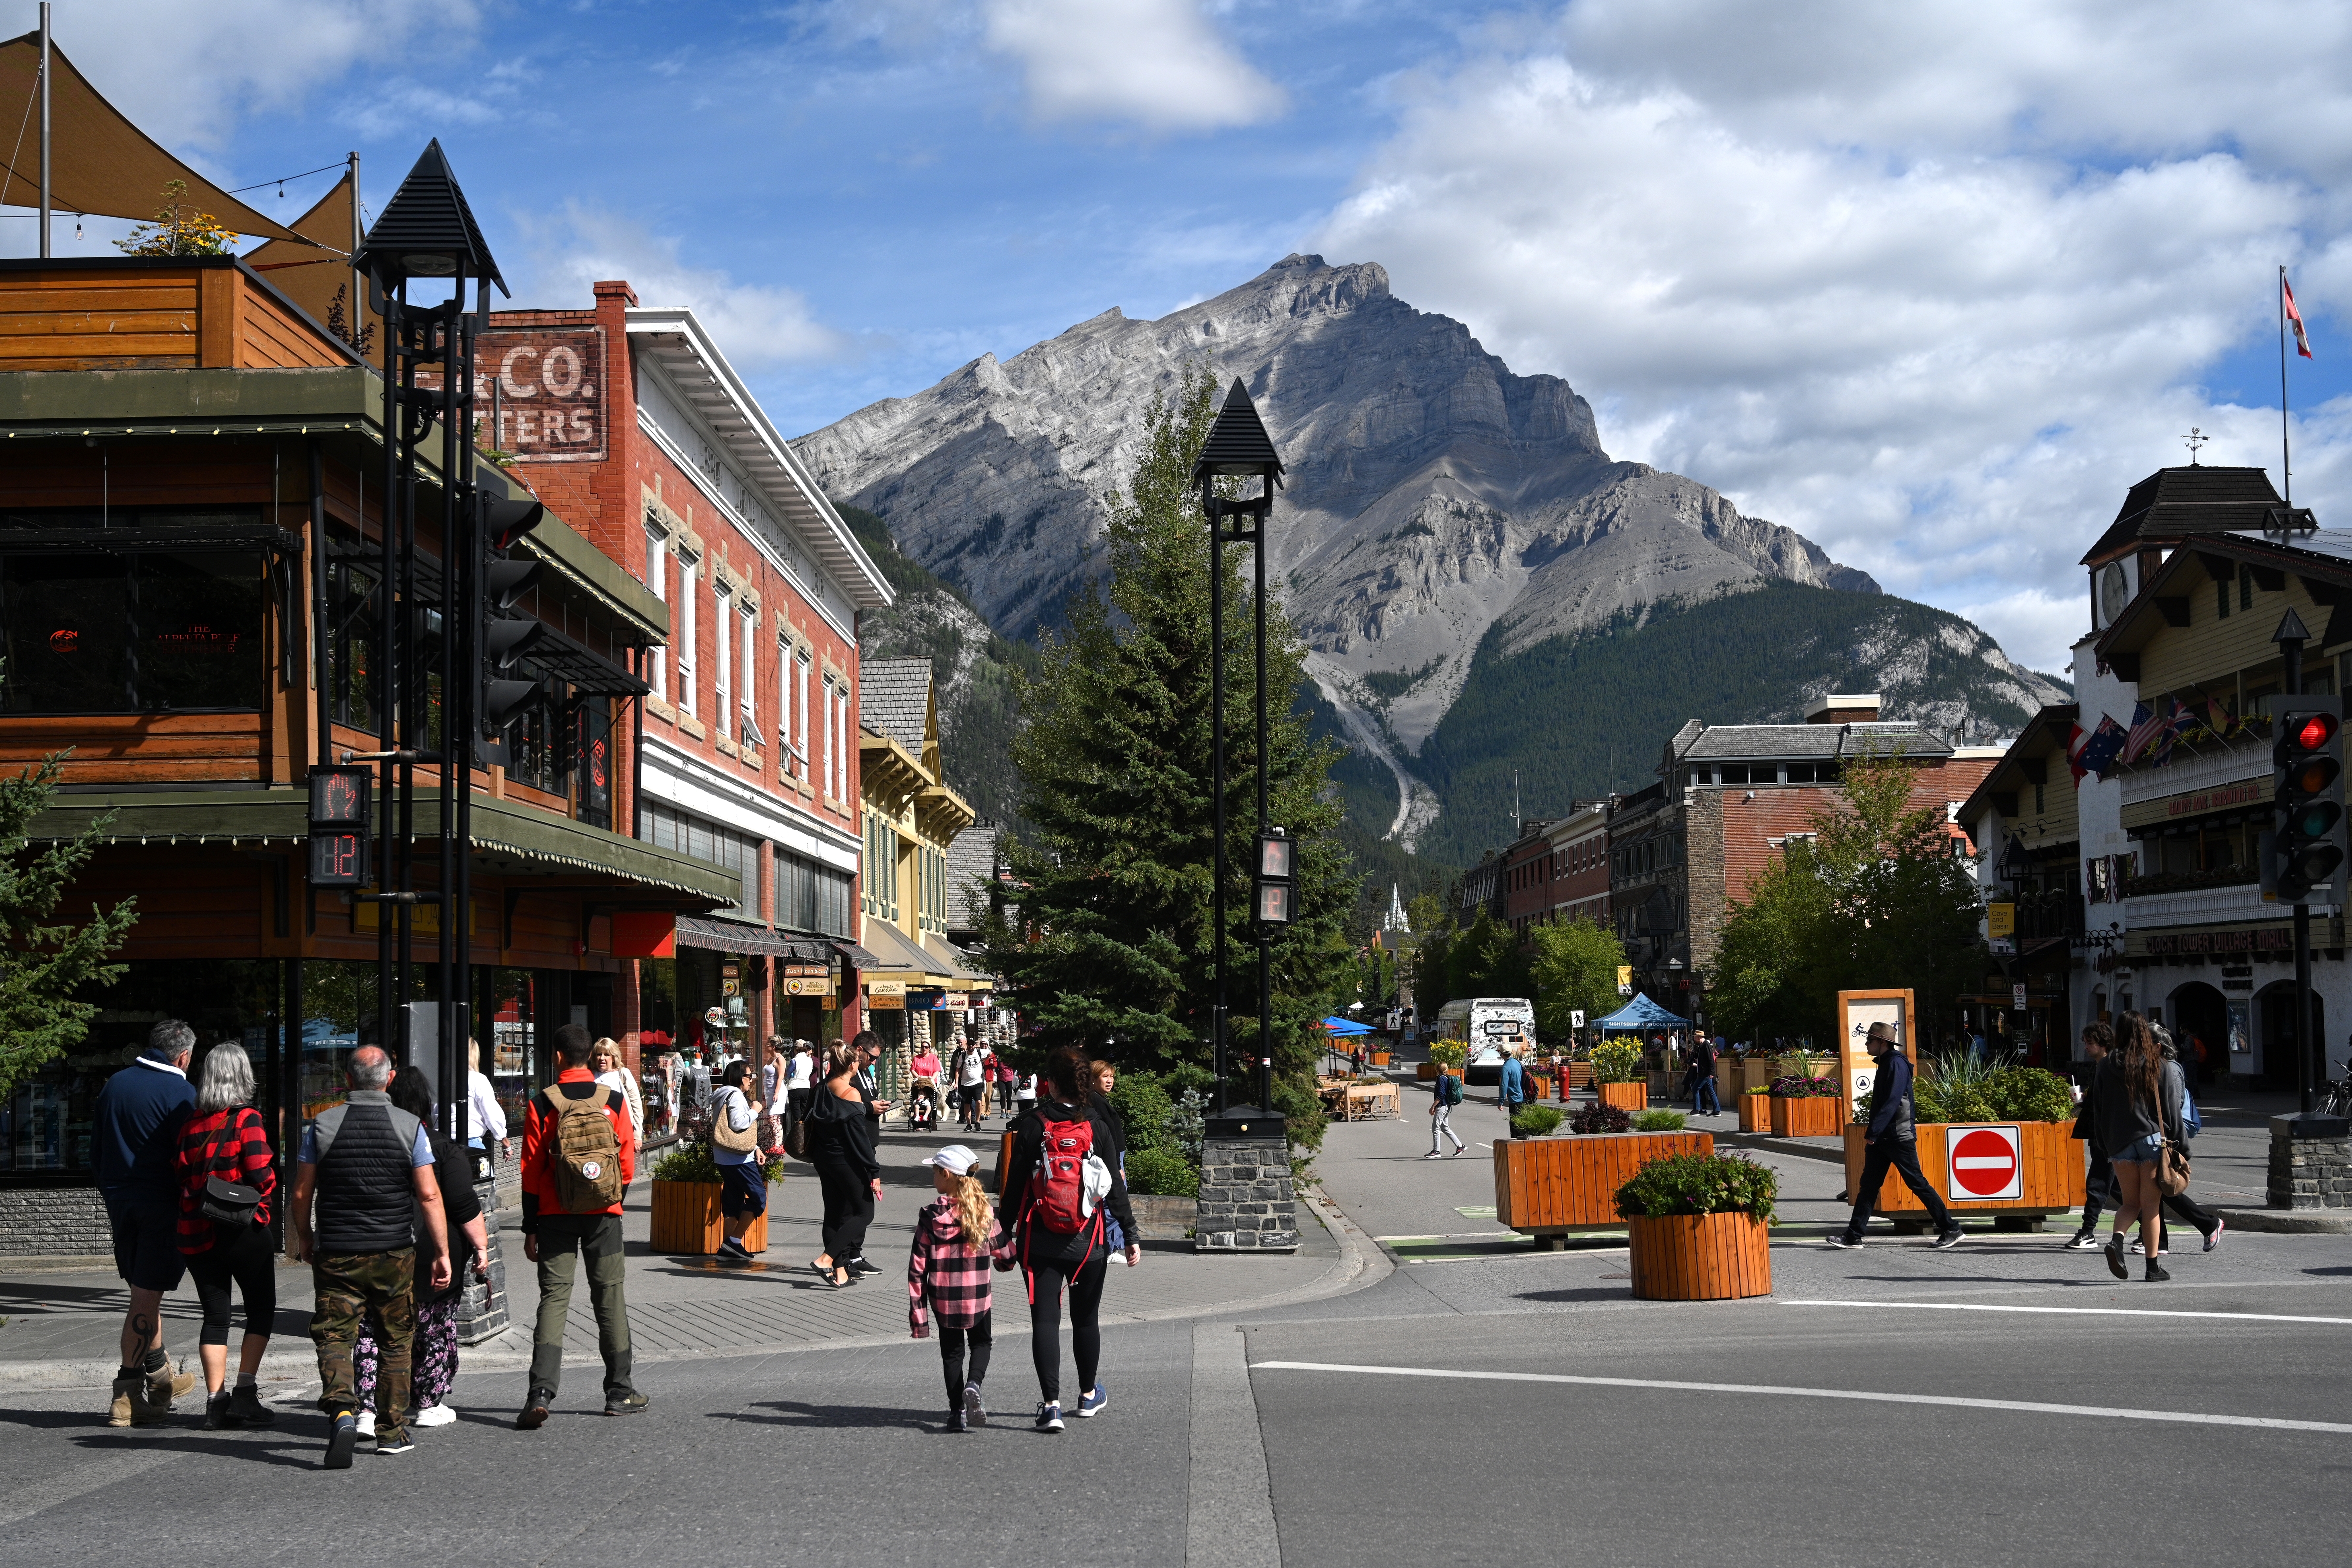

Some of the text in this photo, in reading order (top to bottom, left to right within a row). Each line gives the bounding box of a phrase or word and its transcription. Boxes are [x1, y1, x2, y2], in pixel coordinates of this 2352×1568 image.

[188, 624, 210, 632] THE
[158, 633, 240, 643] ALBERTA BEEF
[163, 644, 235, 654] EXPERIENCE
[2169, 785, 2260, 815] BANFF AVE. BREWING CO.
[334, 835, 355, 875] 12
[2146, 936, 2173, 954] CLOCK
[2177, 934, 2210, 952] TOWER
[2214, 930, 2253, 951] VILLAGE
